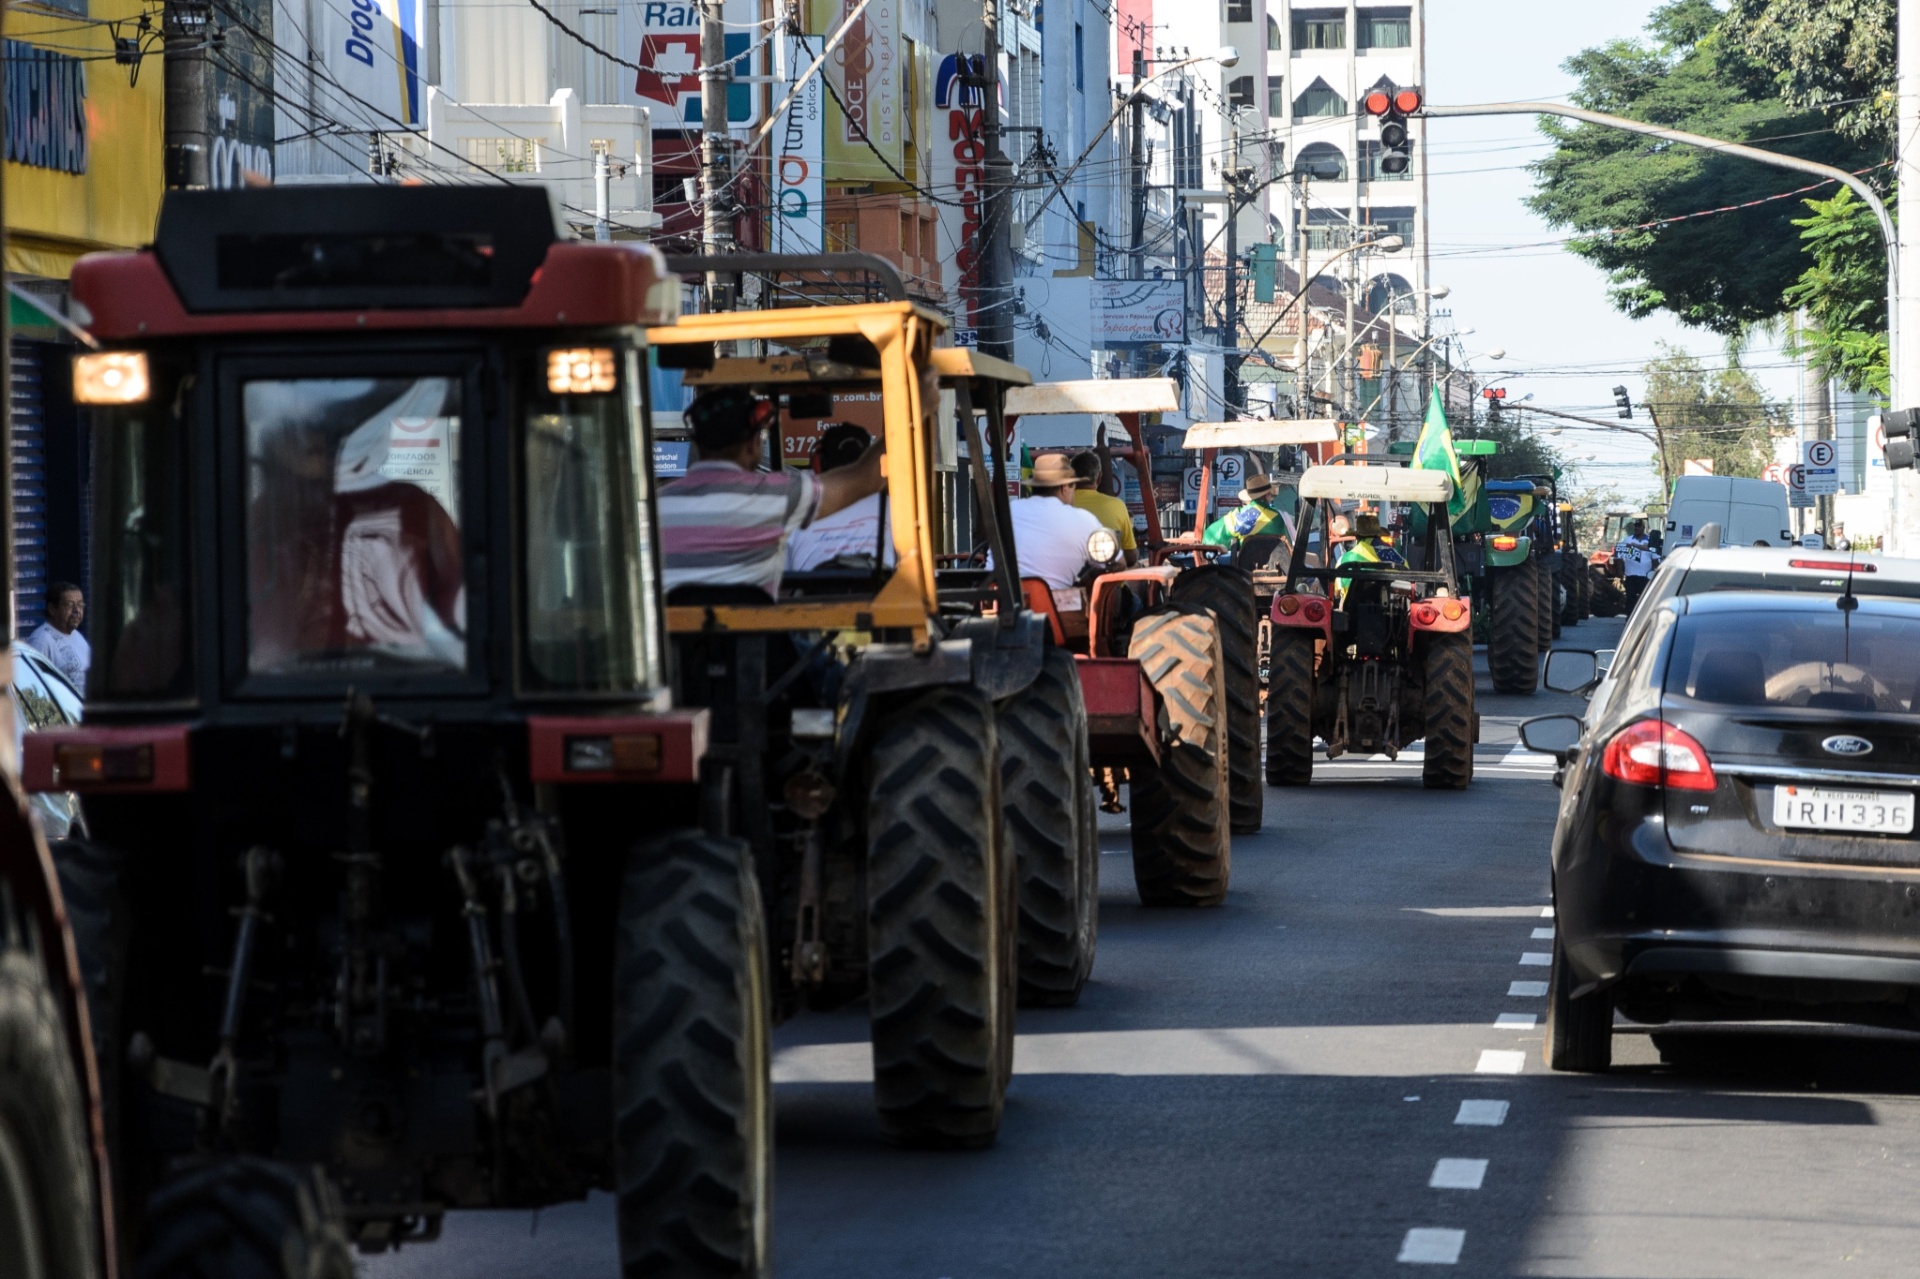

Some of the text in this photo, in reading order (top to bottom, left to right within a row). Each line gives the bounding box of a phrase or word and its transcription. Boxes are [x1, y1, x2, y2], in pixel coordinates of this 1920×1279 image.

[645, 2, 700, 28] Rai
[880, 0, 891, 142] DISTRIBUID
[806, 78, 819, 121] ópticas
[847, 78, 864, 138] DOCE
[1227, 461, 1235, 474] E
[1816, 447, 1826, 461] E
